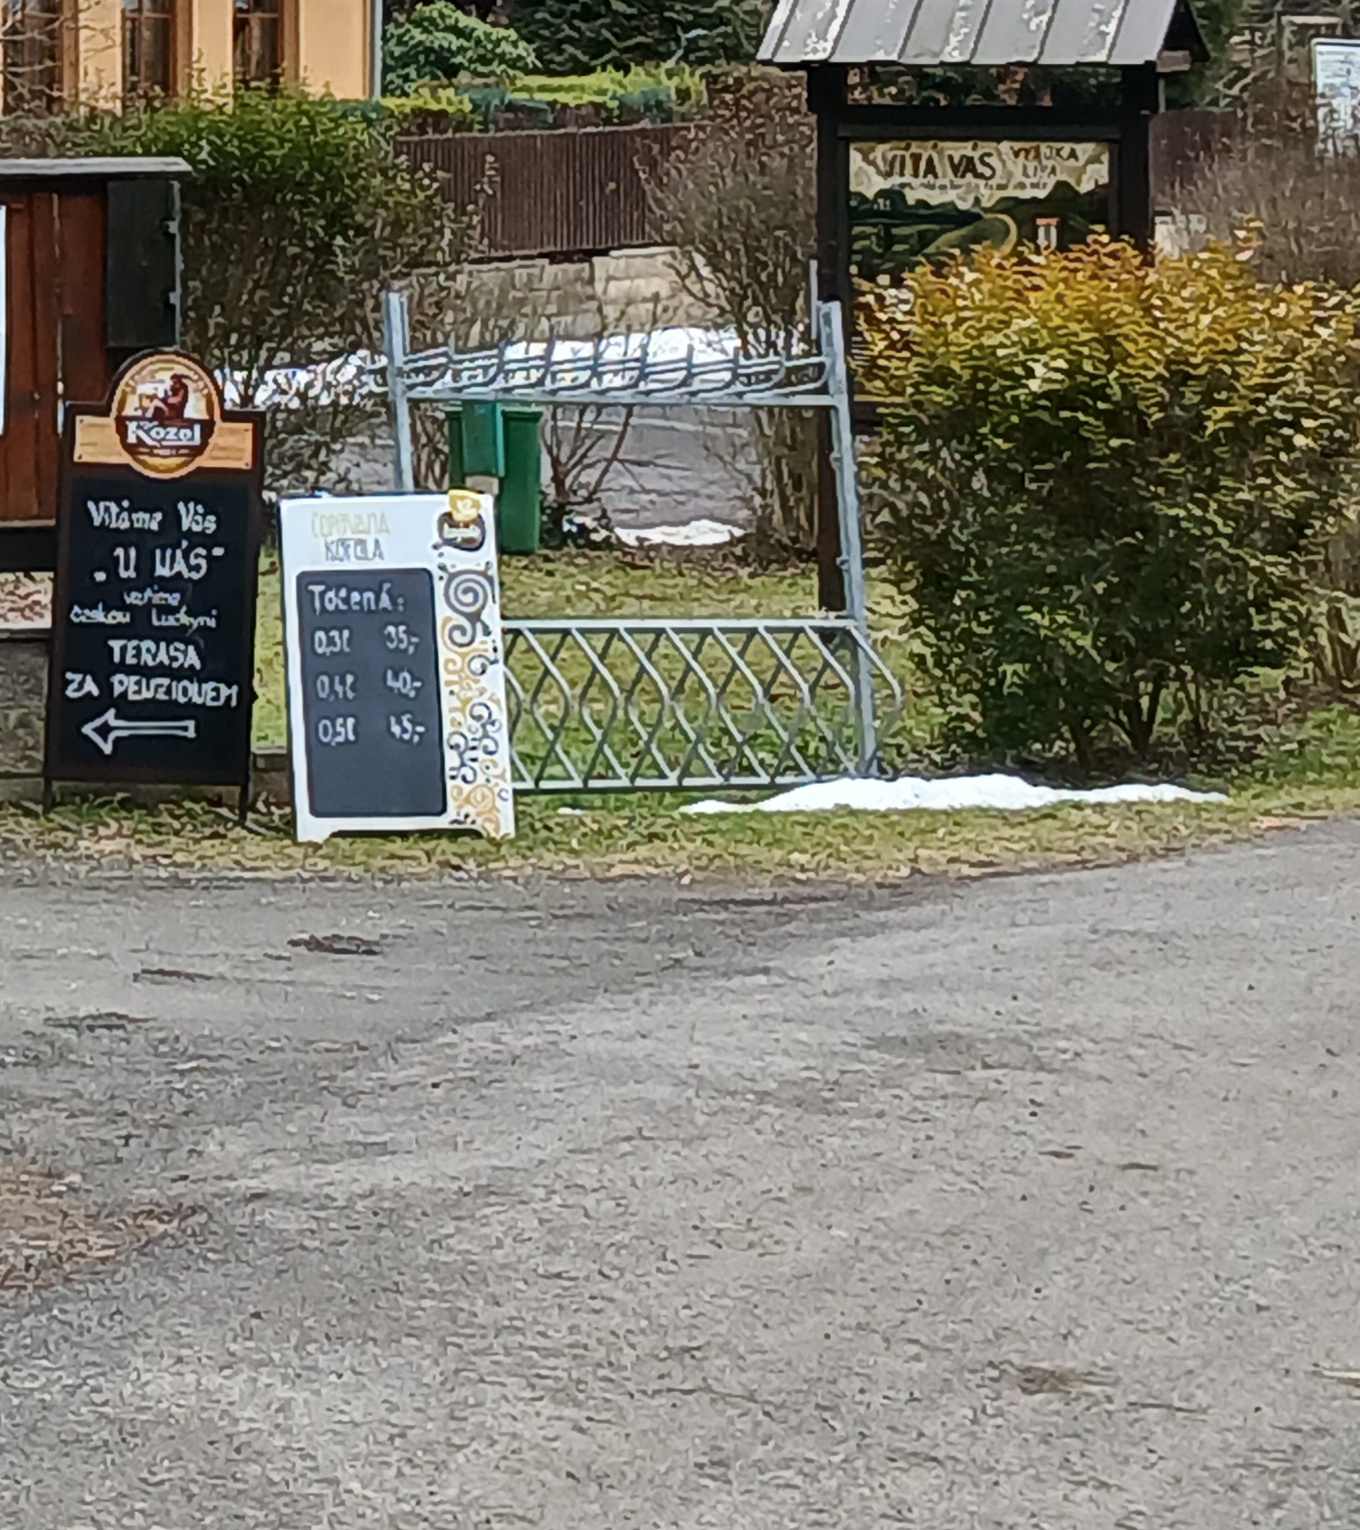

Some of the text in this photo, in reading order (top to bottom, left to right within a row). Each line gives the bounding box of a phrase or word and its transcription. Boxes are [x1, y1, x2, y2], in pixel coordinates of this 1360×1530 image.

[947, 141, 997, 181] VÁS
[126, 419, 202, 448] Kozel
[177, 500, 218, 534] Vás
[107, 639, 202, 670] TERASA
[65, 671, 239, 708] ZA PENZIONEM
